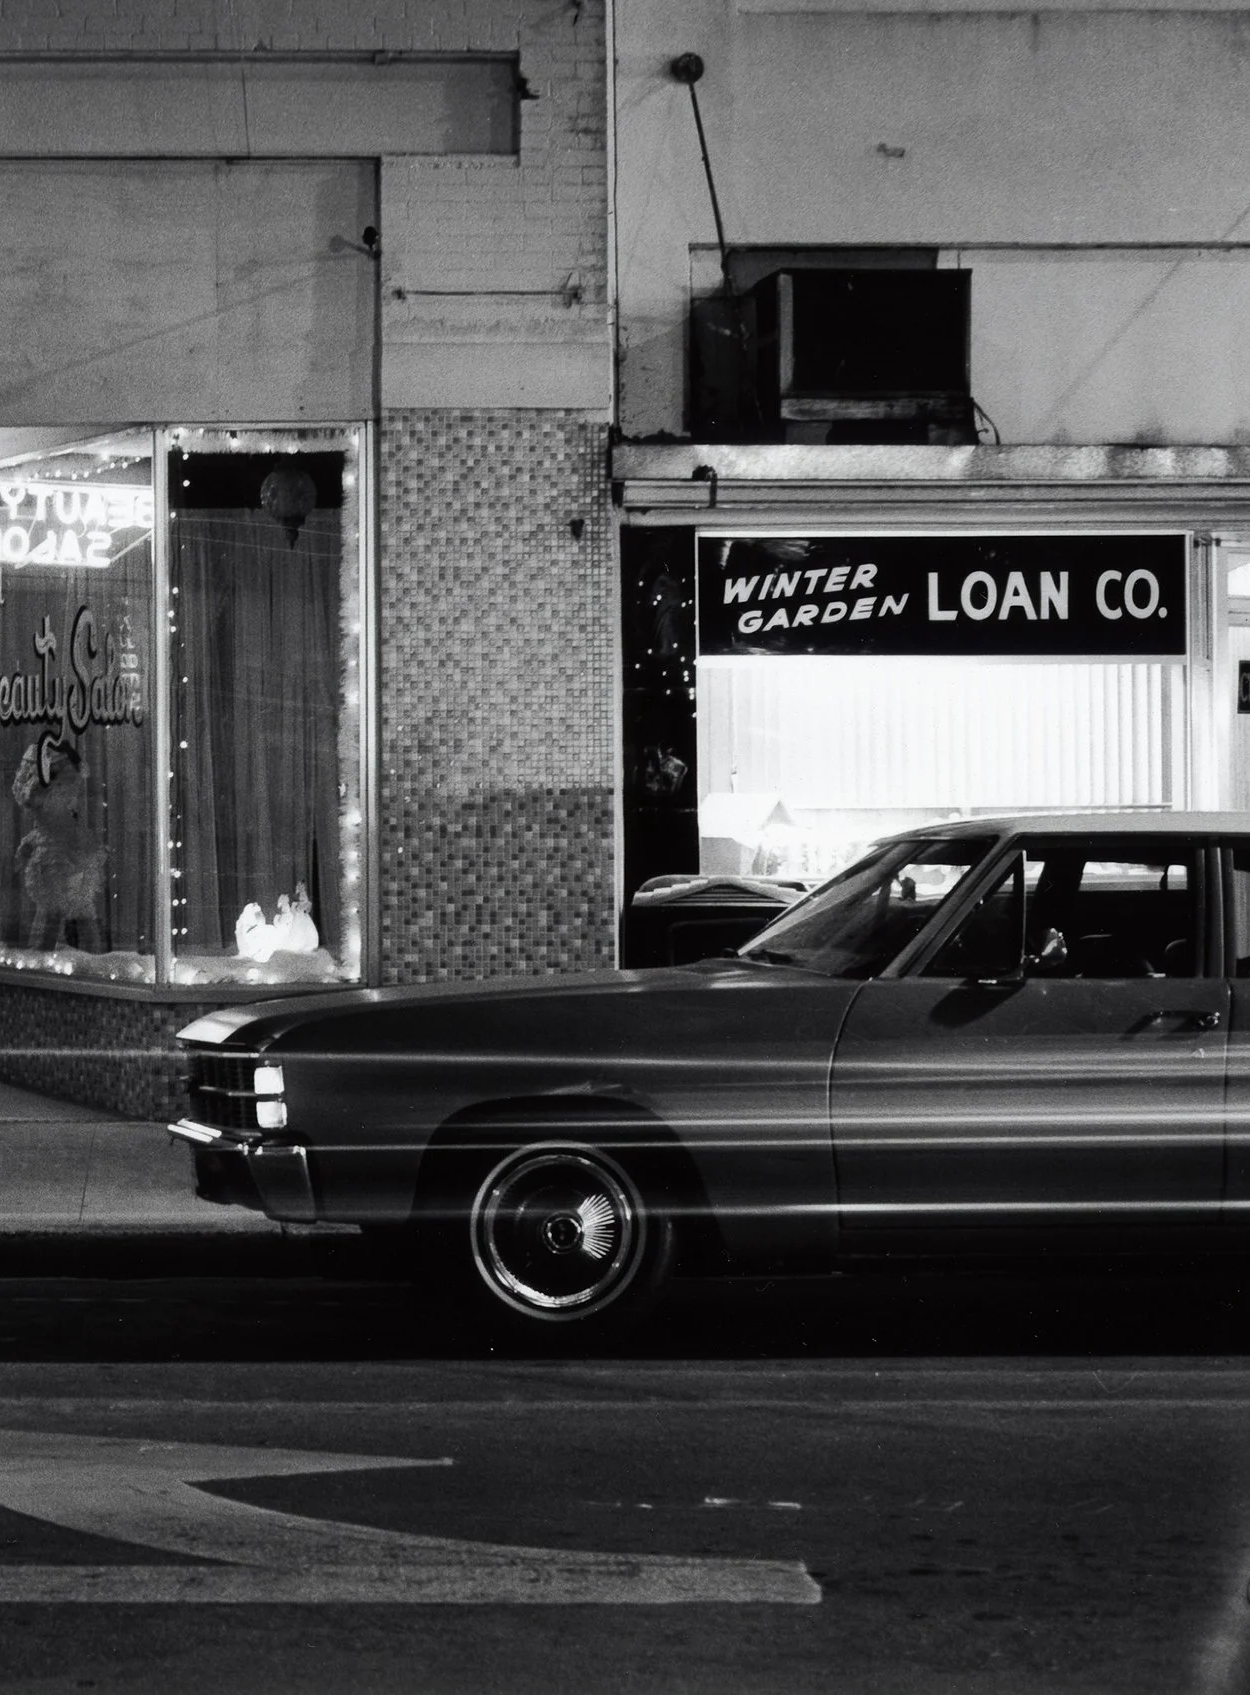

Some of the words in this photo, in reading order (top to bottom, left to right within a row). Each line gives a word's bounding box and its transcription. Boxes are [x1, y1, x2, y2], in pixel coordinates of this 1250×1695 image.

[724, 563, 878, 604] WINTER
[927, 571, 1069, 621] LOAN
[1095, 569, 1167, 619] CO.
[738, 593, 909, 633] GARDEN
[66, 605, 144, 735] Salon
